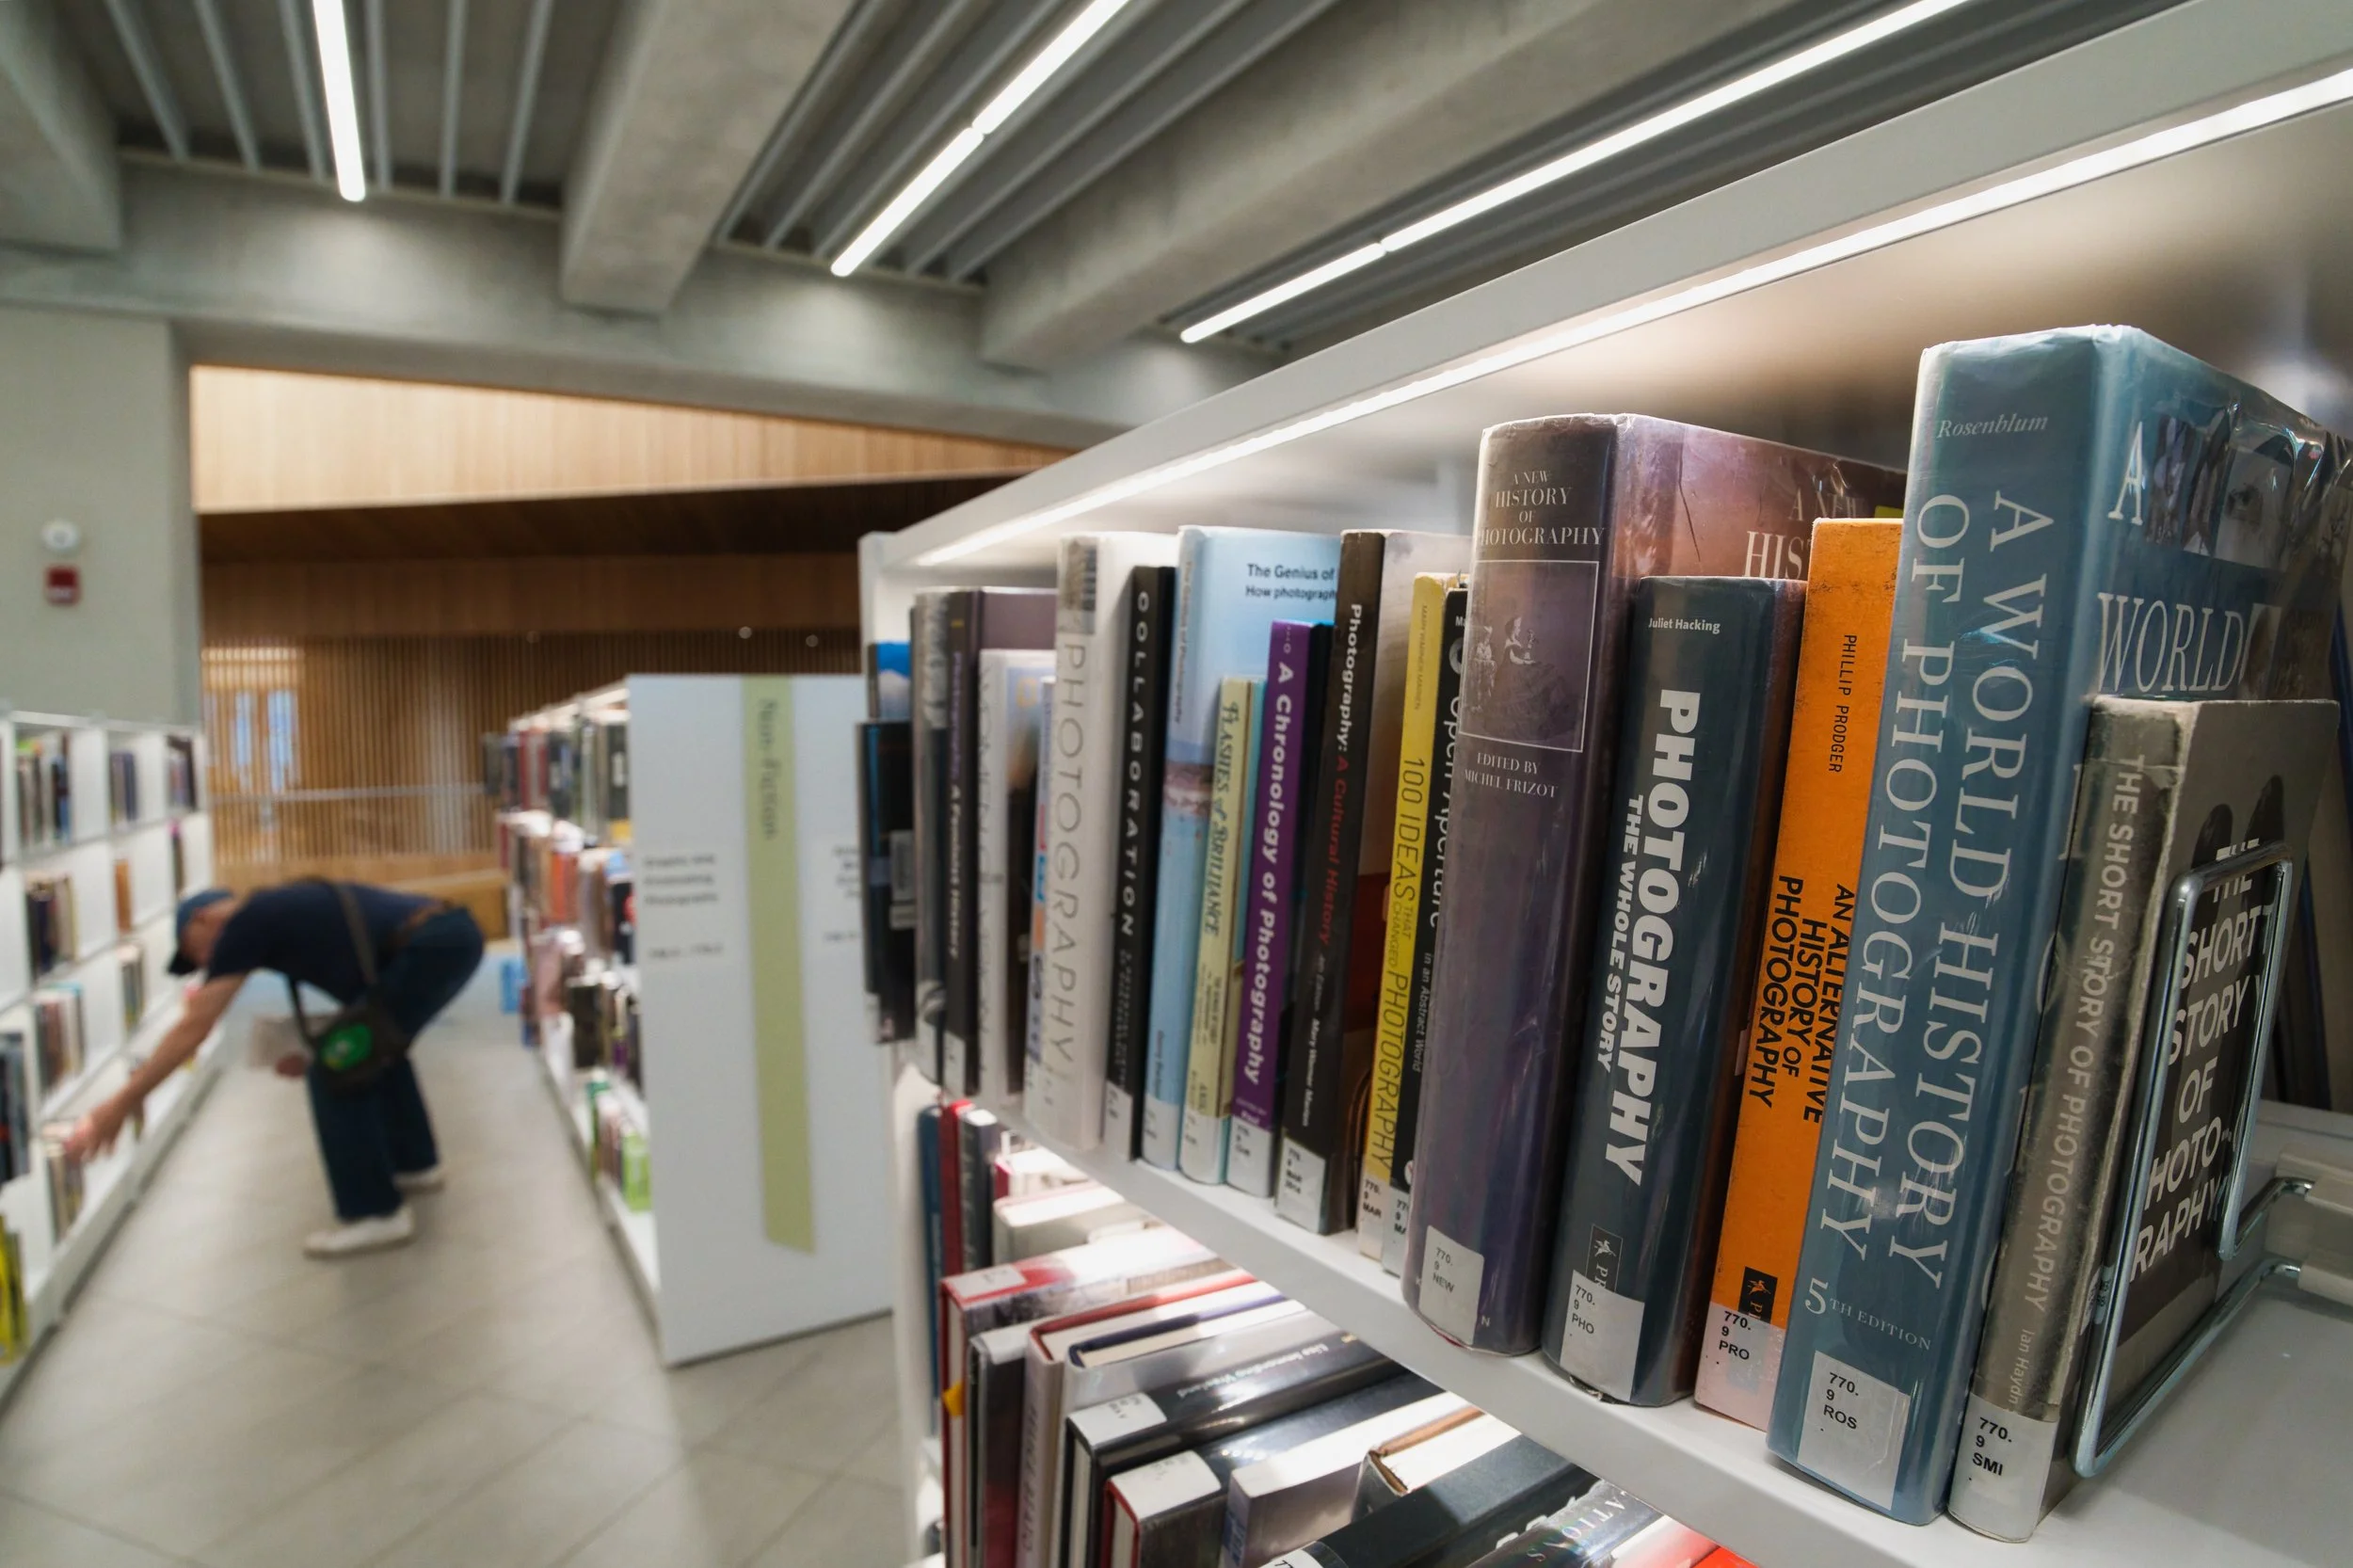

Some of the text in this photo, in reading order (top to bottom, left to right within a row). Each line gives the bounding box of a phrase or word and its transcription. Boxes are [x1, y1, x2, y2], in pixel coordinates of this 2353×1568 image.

[1936, 412, 2049, 440] Rosenblum
[1523, 470, 1551, 485] NEW
[2106, 421, 2144, 526] A
[1495, 487, 1574, 508] HISTORY
[1518, 510, 1536, 523] OF
[1247, 563, 1336, 581] The Genius of
[1744, 530, 1812, 581] HIS
[1245, 584, 1272, 597] How
[1648, 616, 1721, 635] Juliet Hacking
[2096, 591, 2245, 693] WORLD
[1277, 662, 1294, 684] A
[1828, 634, 1858, 773] PHILLIP PRODGER
[1121, 591, 1149, 936] COLLABORATION
[1262, 694, 1292, 865] Chronology
[1337, 755, 1350, 772] A
[1477, 752, 1542, 775] EDITED BY
[1465, 768, 1559, 798] MICHEL FRIZOT
[1328, 778, 1347, 865] Cultural
[1393, 758, 1426, 902] 100 IDEAS
[1049, 643, 1086, 1064] PHOTOGRAPHY
[1261, 871, 1277, 904] of
[1820, 494, 1970, 1262] OF PHOTOGRAPHY
[1888, 489, 2055, 1289] A WORLD HISTORY
[1319, 868, 1338, 945] History
[1833, 883, 1855, 922] AN
[1388, 901, 1401, 968] CHANGED
[1401, 904, 1415, 940] THAT
[1597, 794, 1644, 1073] THE WHOLE STORY
[1605, 689, 1701, 1187] PHOTOGRAPHY
[1243, 908, 1275, 1086] Photography
[1749, 875, 1803, 1109] PHOTOGRAPHY
[1783, 918, 1828, 1078] HISTORY OF
[1416, 985, 1431, 1036] Abstract
[2025, 754, 2146, 1313] THE SHORT STORY OF PHOTOGRAPHY
[1371, 970, 1409, 1172] PHOTOGRAPHY
[1412, 1038, 1425, 1073] World
[2179, 1056, 2218, 1124] OF
[2144, 1116, 2232, 1211] HOTO-
[1362, 1202, 1383, 1218] MAR
[2129, 1176, 2220, 1284] RAPHY
[1433, 1260, 1441, 1271] 9
[1435, 1247, 1453, 1266] 770.
[1432, 1272, 1456, 1293] NEW
[1575, 1284, 1595, 1305] 770.
[1573, 1299, 1580, 1309] 9
[1723, 1310, 1752, 1331] 770.
[1571, 1313, 1594, 1335] PHO
[1721, 1325, 1730, 1336] 9
[1857, 1310, 1931, 1352] EDITION
[1719, 1339, 1750, 1361] PRO
[2009, 1328, 2035, 1405] Ian Haydn
[1826, 1388, 1835, 1401] 9
[1829, 1371, 1859, 1397] 770.
[1823, 1404, 1858, 1430] ROS
[1978, 1416, 2012, 1443] 770.
[1975, 1434, 1985, 1448] 9
[1972, 1452, 2004, 1476] SMI
